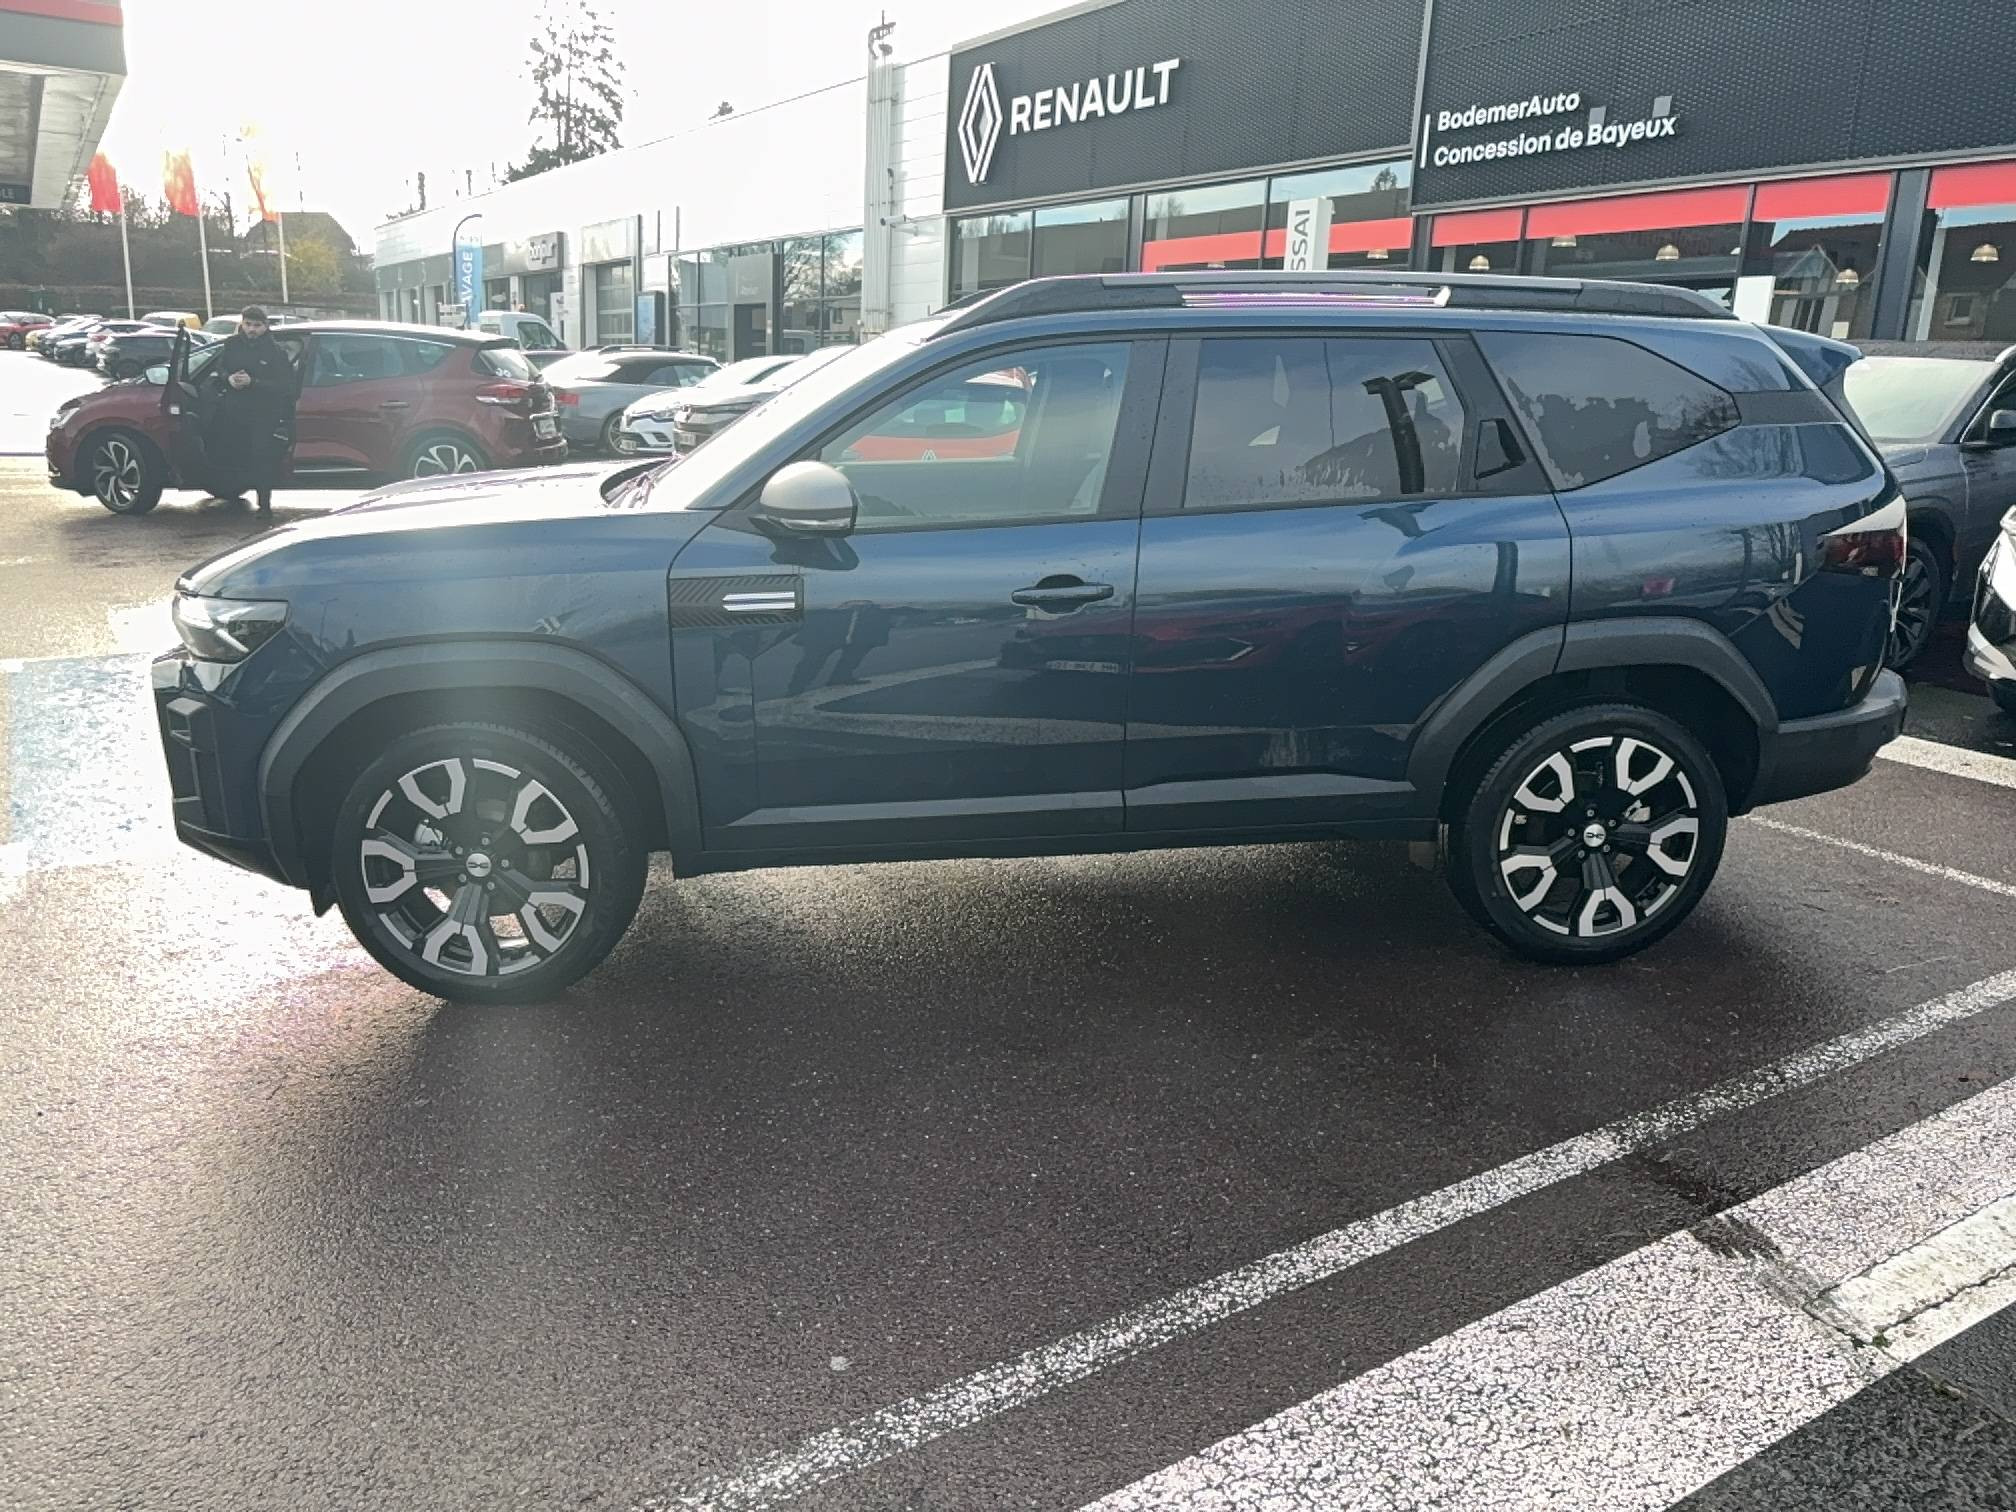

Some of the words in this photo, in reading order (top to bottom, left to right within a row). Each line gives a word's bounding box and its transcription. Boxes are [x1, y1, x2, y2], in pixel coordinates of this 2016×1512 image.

[1010, 57, 1180, 136] RENAULT
[1437, 92, 1581, 132] BodemerAuto
[1433, 132, 1551, 167] Concession
[1554, 126, 1584, 151] de
[1586, 116, 1678, 148] Bayeux
